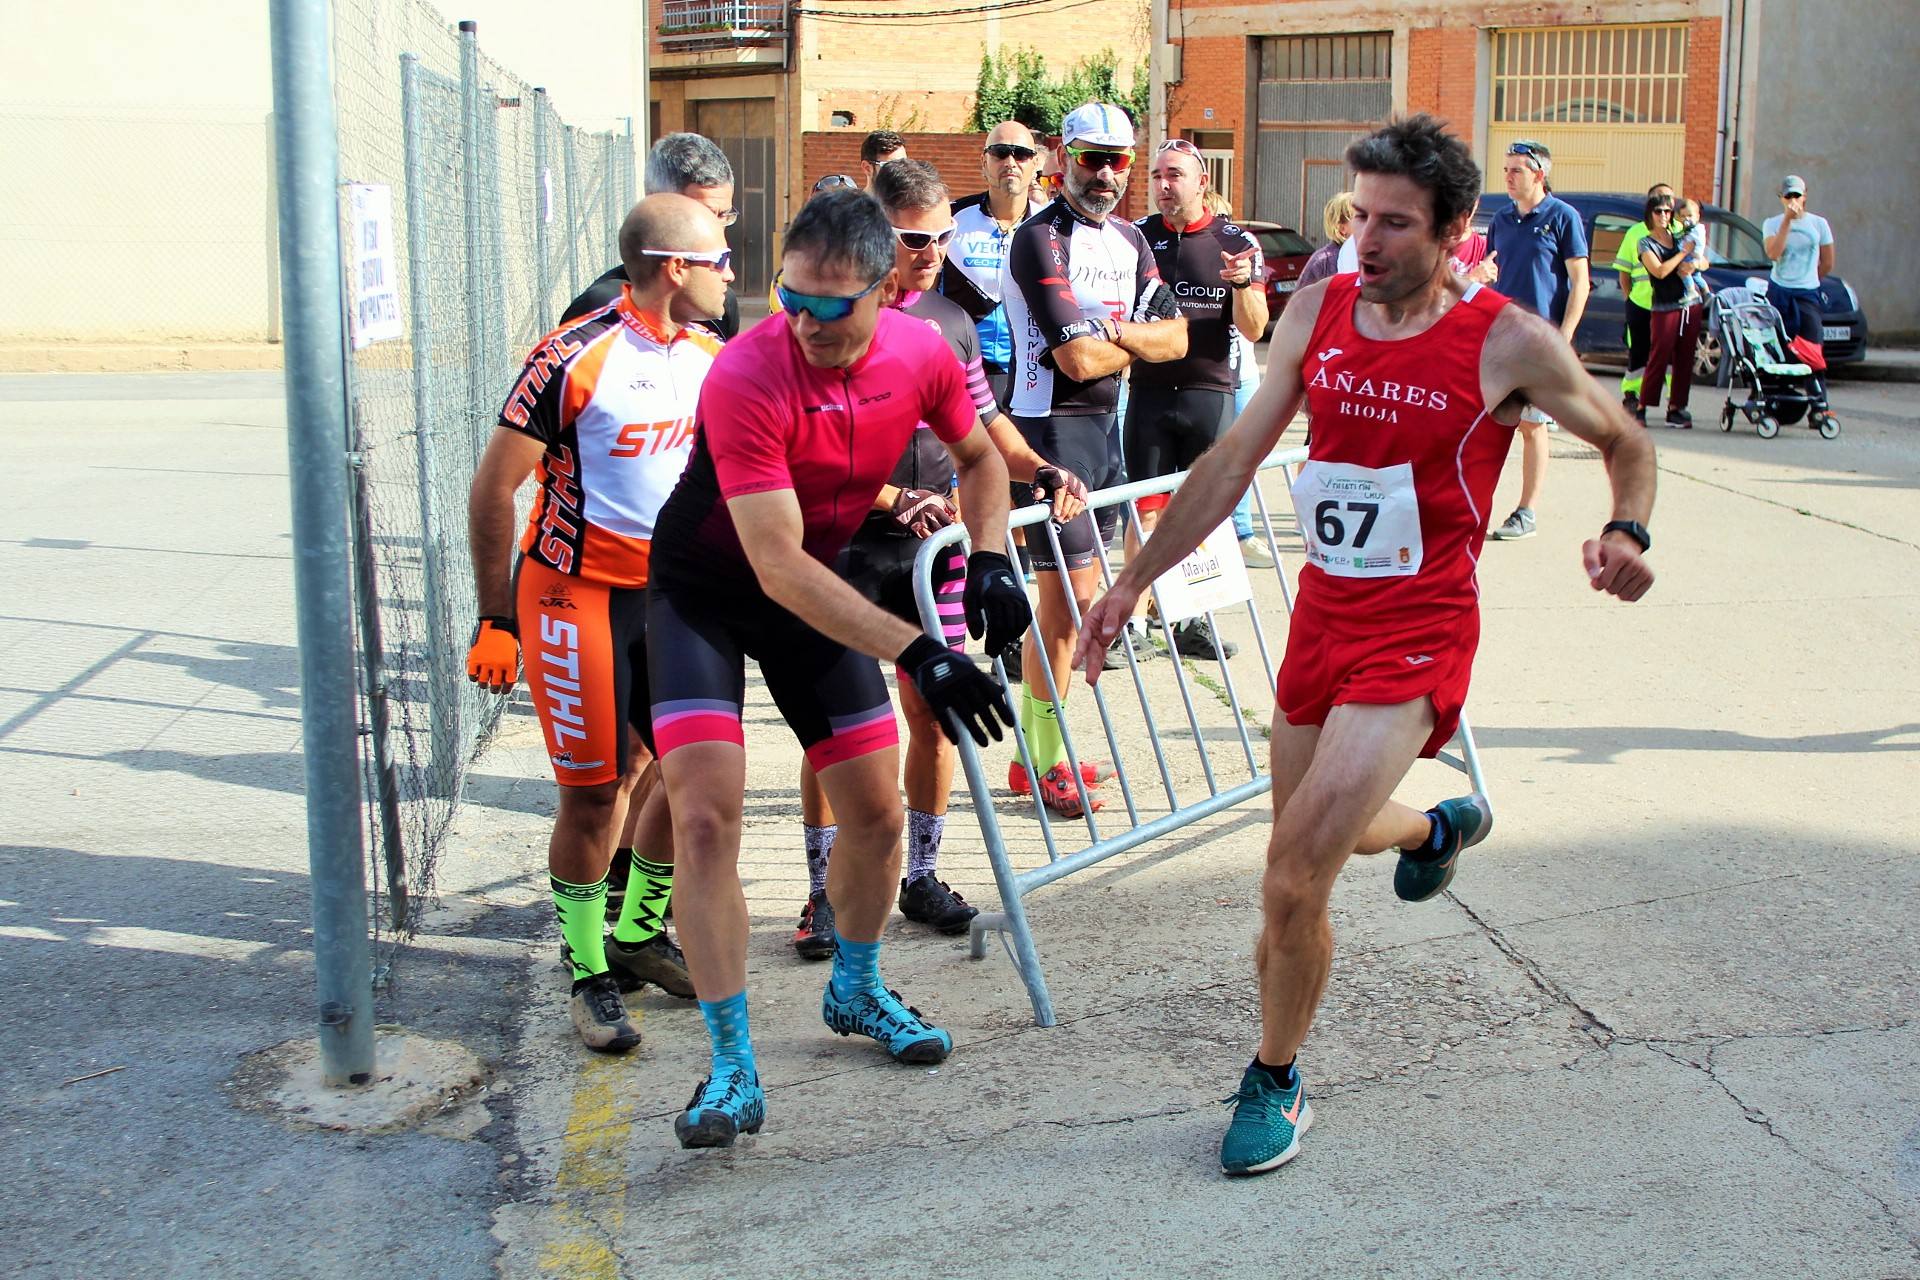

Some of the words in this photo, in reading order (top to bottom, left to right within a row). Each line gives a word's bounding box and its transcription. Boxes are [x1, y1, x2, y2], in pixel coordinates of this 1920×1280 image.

[1175, 281, 1226, 300] Group
[1181, 302, 1223, 310] AUTOMATION
[503, 338, 584, 428] STIHL
[1026, 341, 1039, 392] ROGER
[1309, 365, 1449, 412] AÑARES
[608, 416, 696, 458] STIH
[1340, 401, 1399, 425] RIOJA
[539, 443, 579, 575] STIHL
[1315, 499, 1380, 549] 67
[540, 613, 588, 750] STIHL
